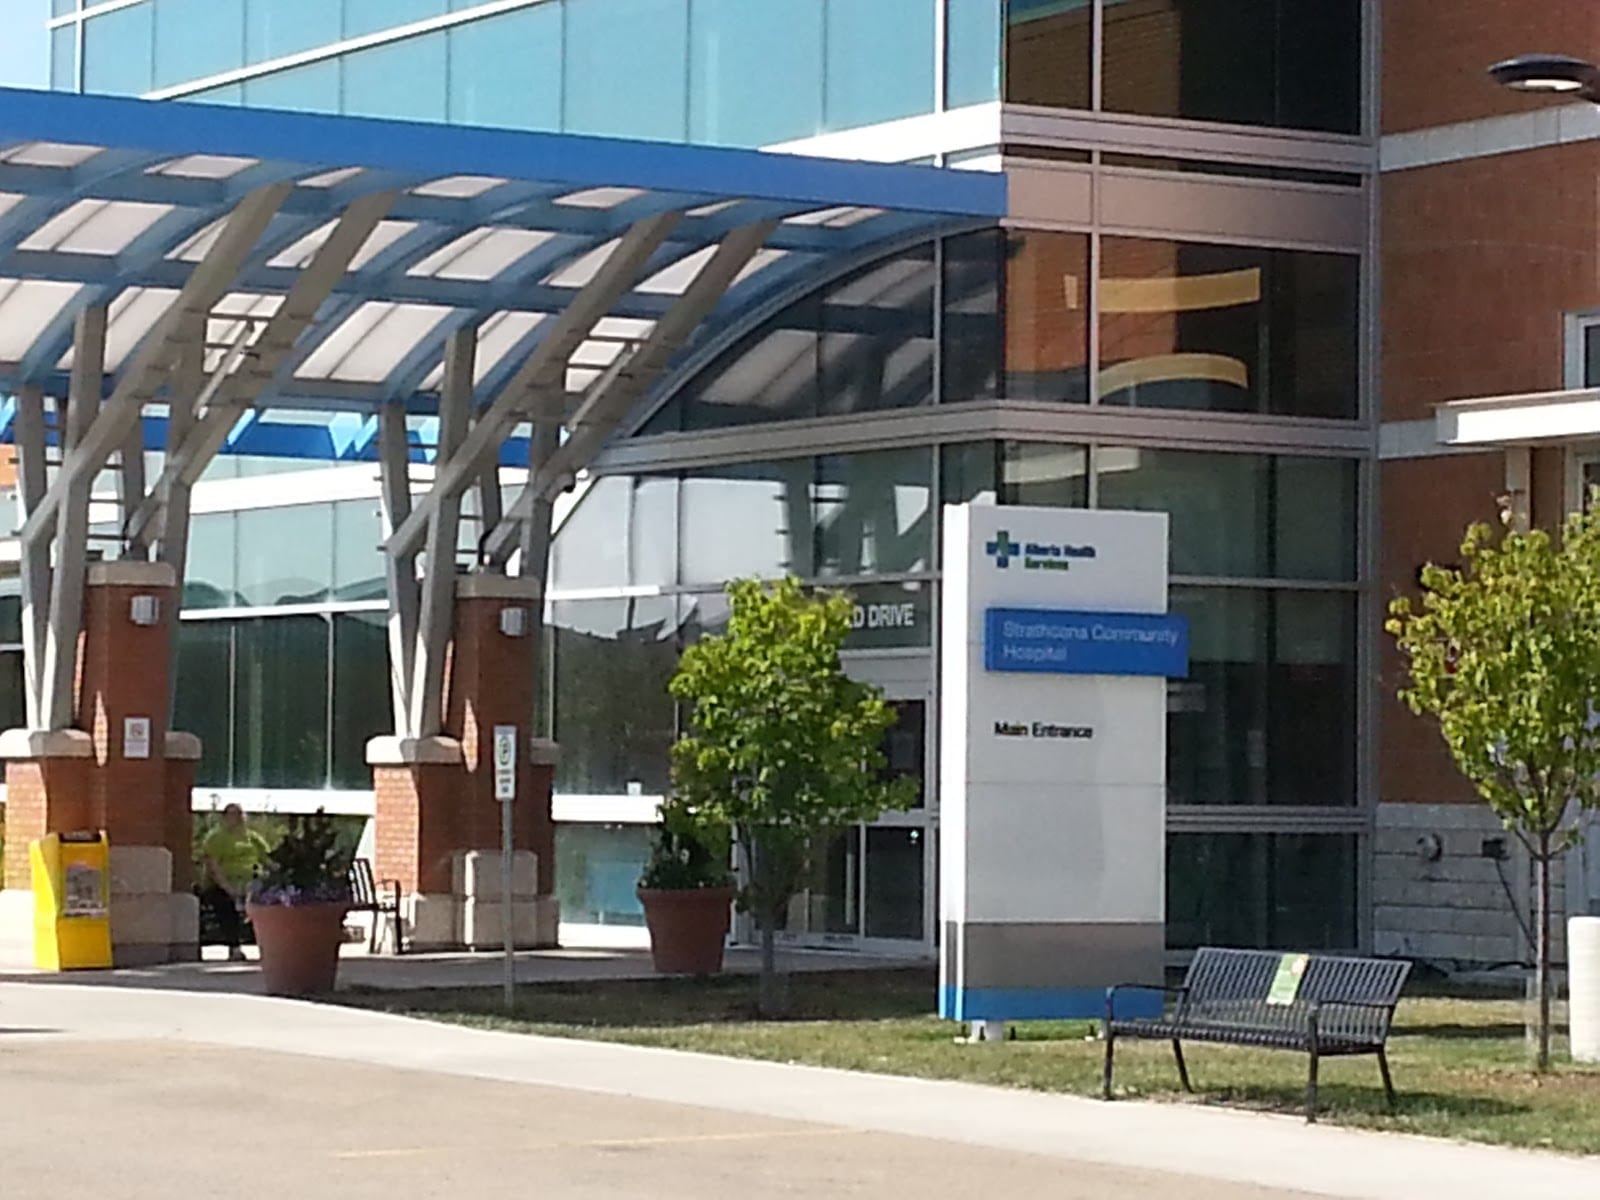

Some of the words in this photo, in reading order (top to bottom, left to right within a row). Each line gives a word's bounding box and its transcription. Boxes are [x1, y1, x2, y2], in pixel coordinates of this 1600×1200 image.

[1064, 545, 1096, 557] Health
[867, 603, 914, 628] DRIVE
[1003, 620, 1088, 640] Strathcona
[1092, 623, 1179, 646] Community
[1003, 644, 1067, 662] Hospital
[994, 721, 1028, 736] Main
[1032, 722, 1093, 738] Entrance
